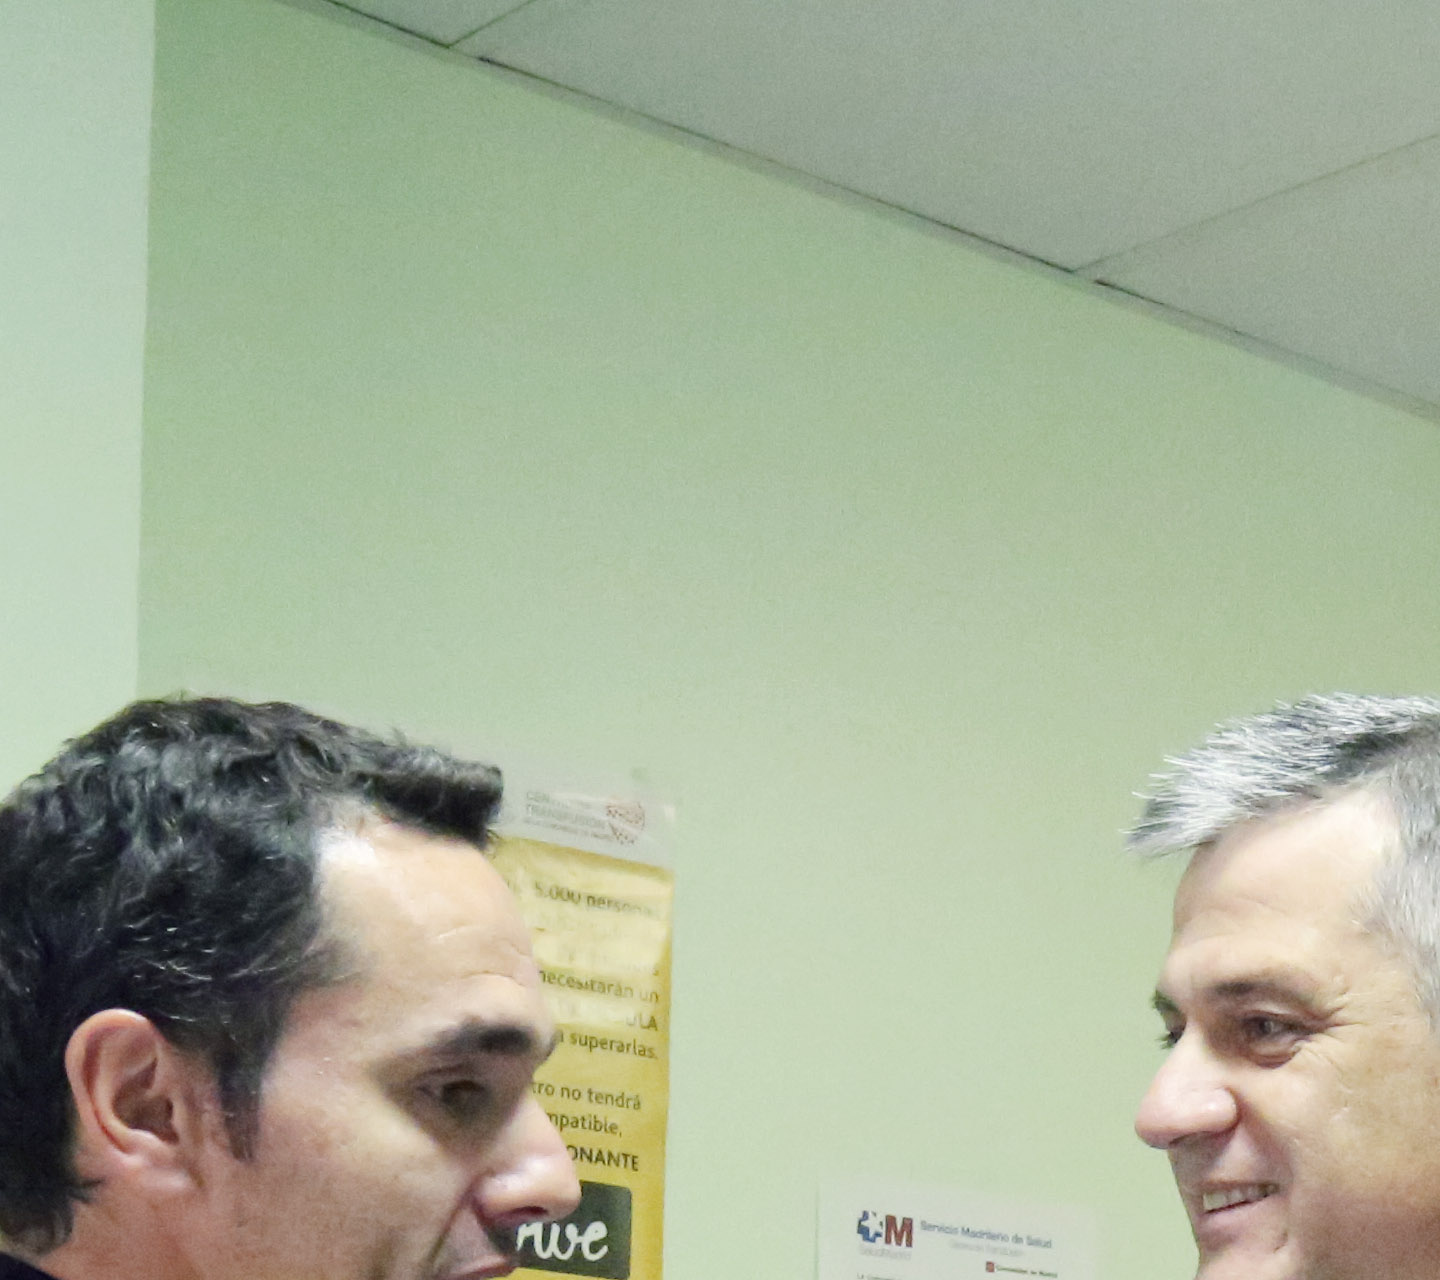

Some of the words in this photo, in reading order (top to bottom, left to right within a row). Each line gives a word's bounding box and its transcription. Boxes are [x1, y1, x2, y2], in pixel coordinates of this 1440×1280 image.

[560, 1087, 582, 1102] no
[587, 1087, 642, 1110] tendrá
[546, 1111, 623, 1138] mpatible,
[566, 1144, 640, 1172] ONANTE
